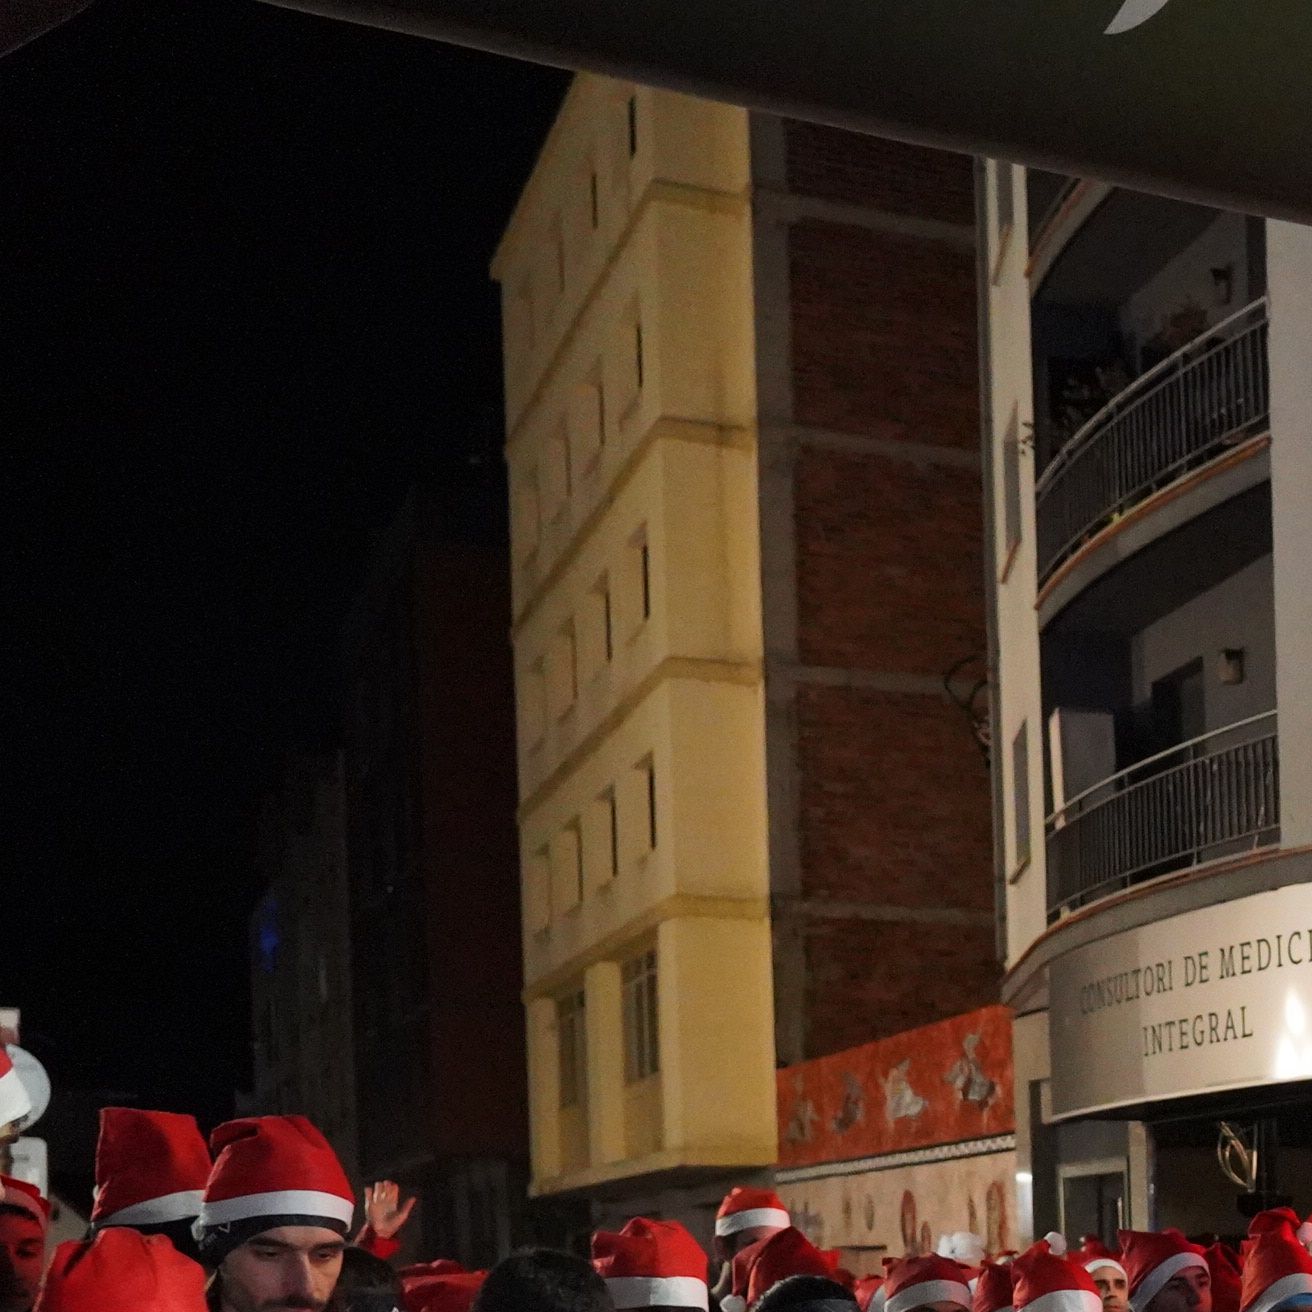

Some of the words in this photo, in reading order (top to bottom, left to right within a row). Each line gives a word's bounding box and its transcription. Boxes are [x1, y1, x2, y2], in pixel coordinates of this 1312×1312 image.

[1081, 961, 1173, 1014] CONSULTORI
[1184, 951, 1209, 987] DE
[1143, 1006, 1253, 1057] INTEGRAL
